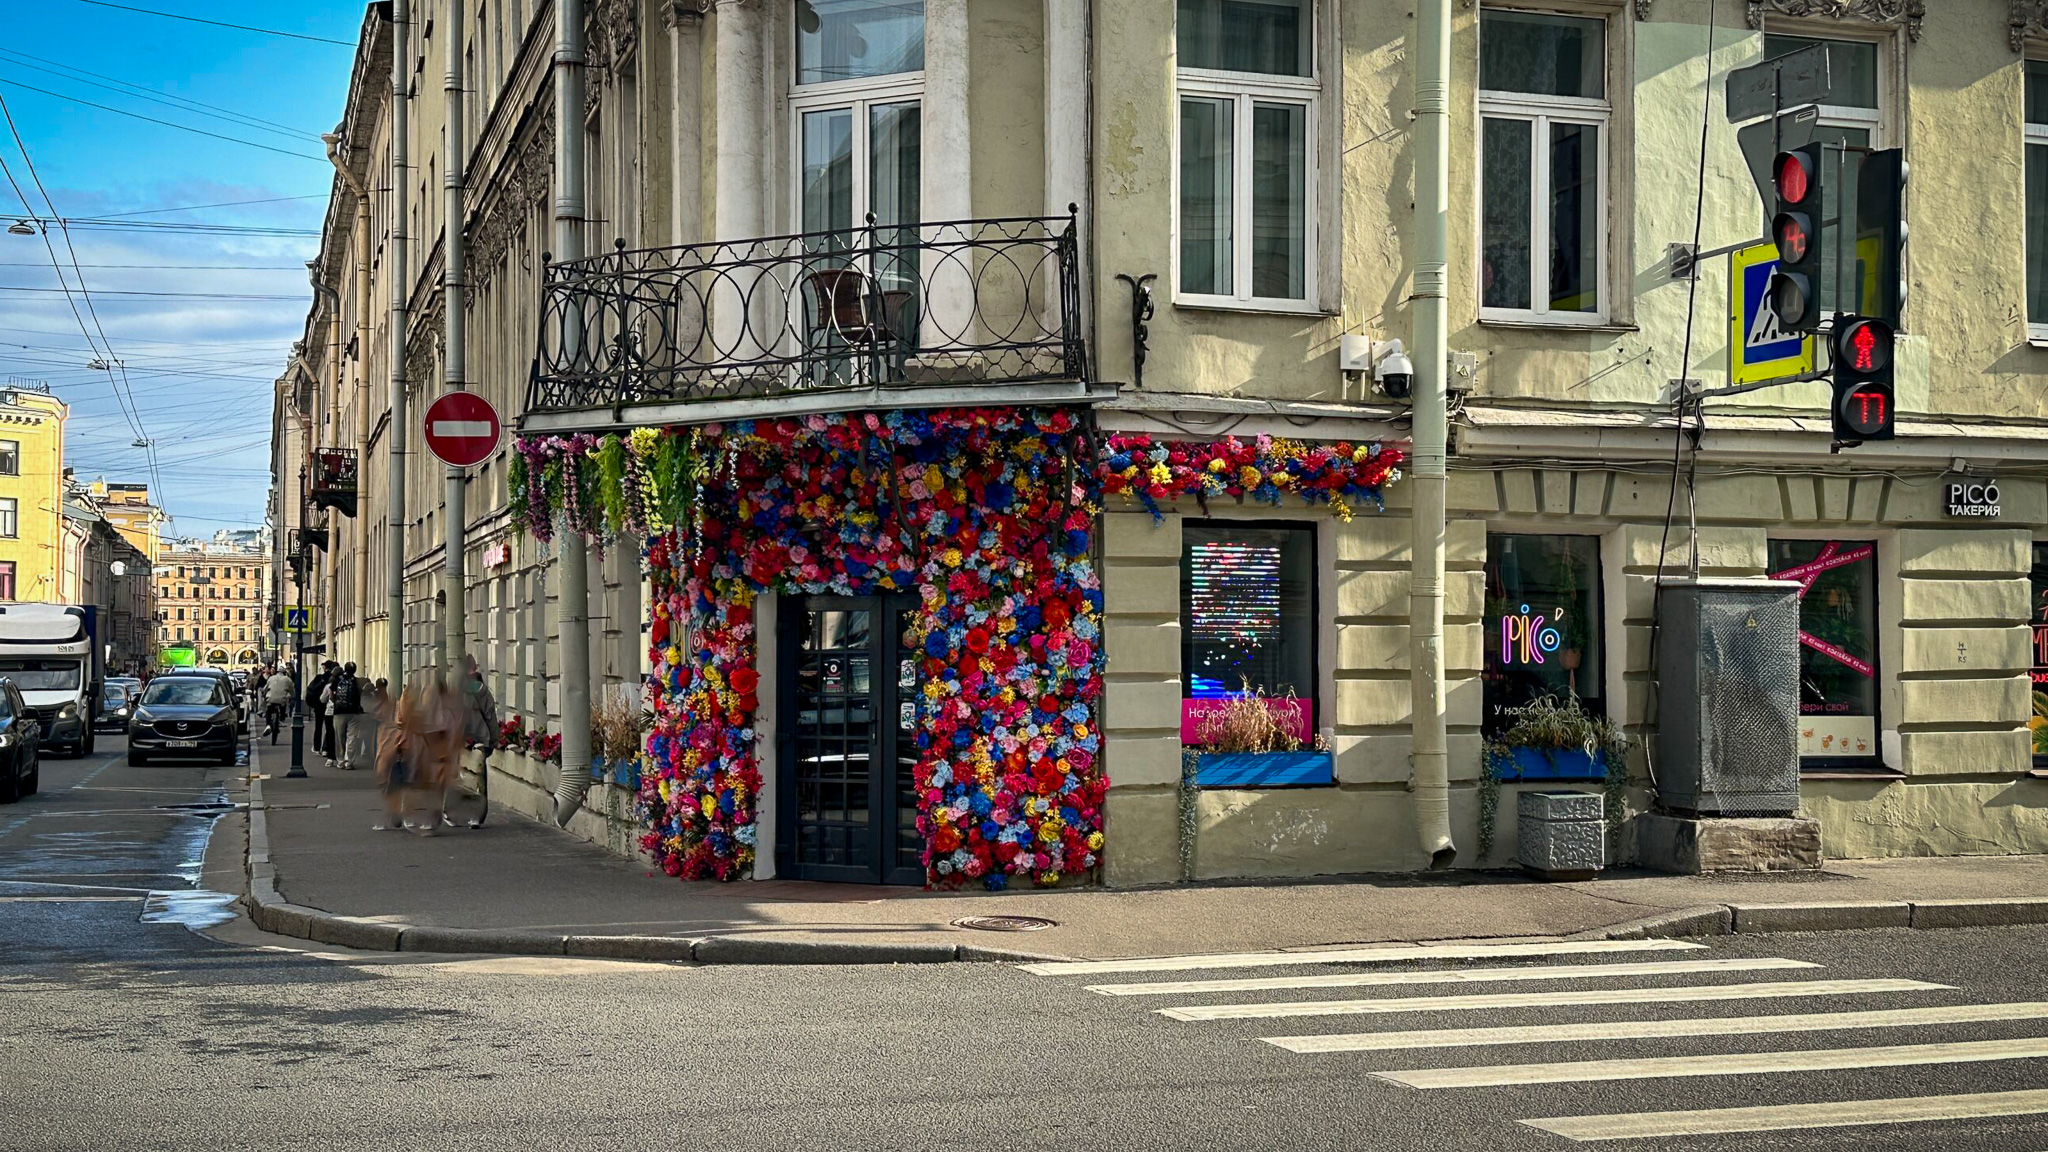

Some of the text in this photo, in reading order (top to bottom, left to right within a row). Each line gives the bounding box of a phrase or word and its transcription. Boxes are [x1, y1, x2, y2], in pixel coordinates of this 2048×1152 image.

[1852, 392, 1885, 424] 77
[1949, 504, 2001, 516] ТАКЕРИЯ
[1825, 701, 1849, 711] свой
